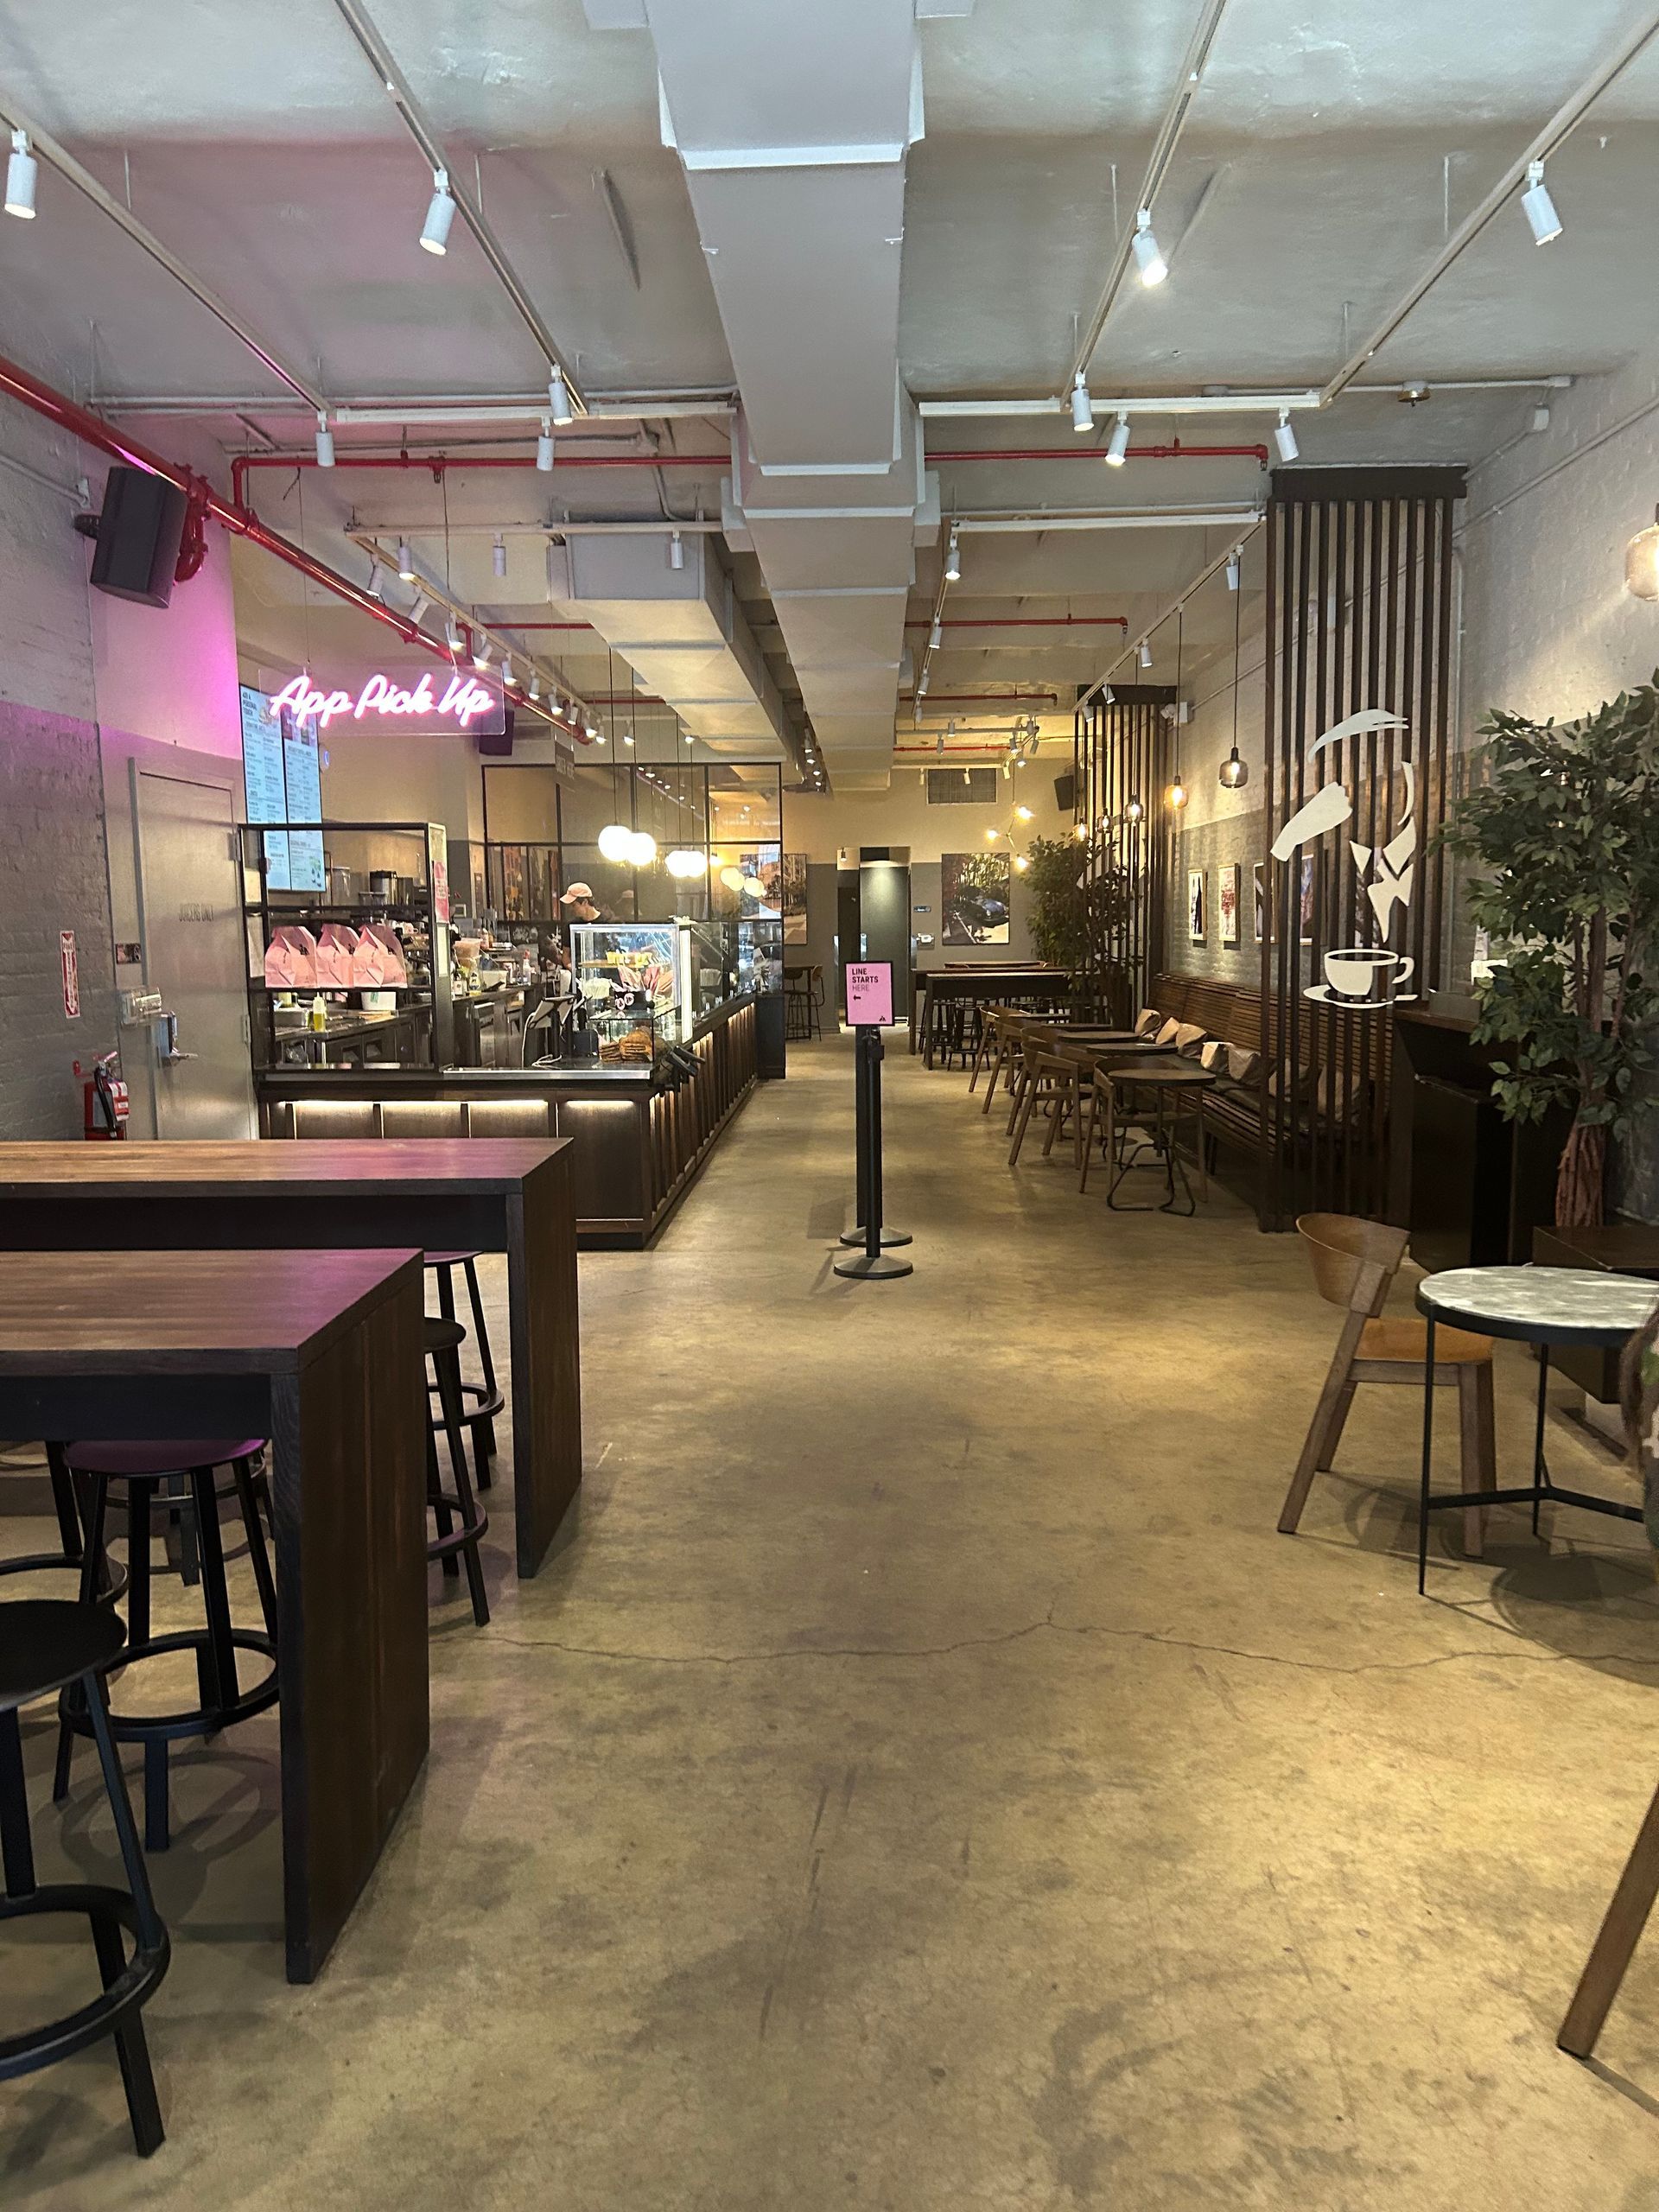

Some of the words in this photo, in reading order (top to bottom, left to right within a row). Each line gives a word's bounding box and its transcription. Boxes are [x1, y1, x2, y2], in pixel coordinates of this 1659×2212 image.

[269, 675, 353, 728] App
[353, 673, 435, 720] Pick
[437, 675, 496, 728] Up
